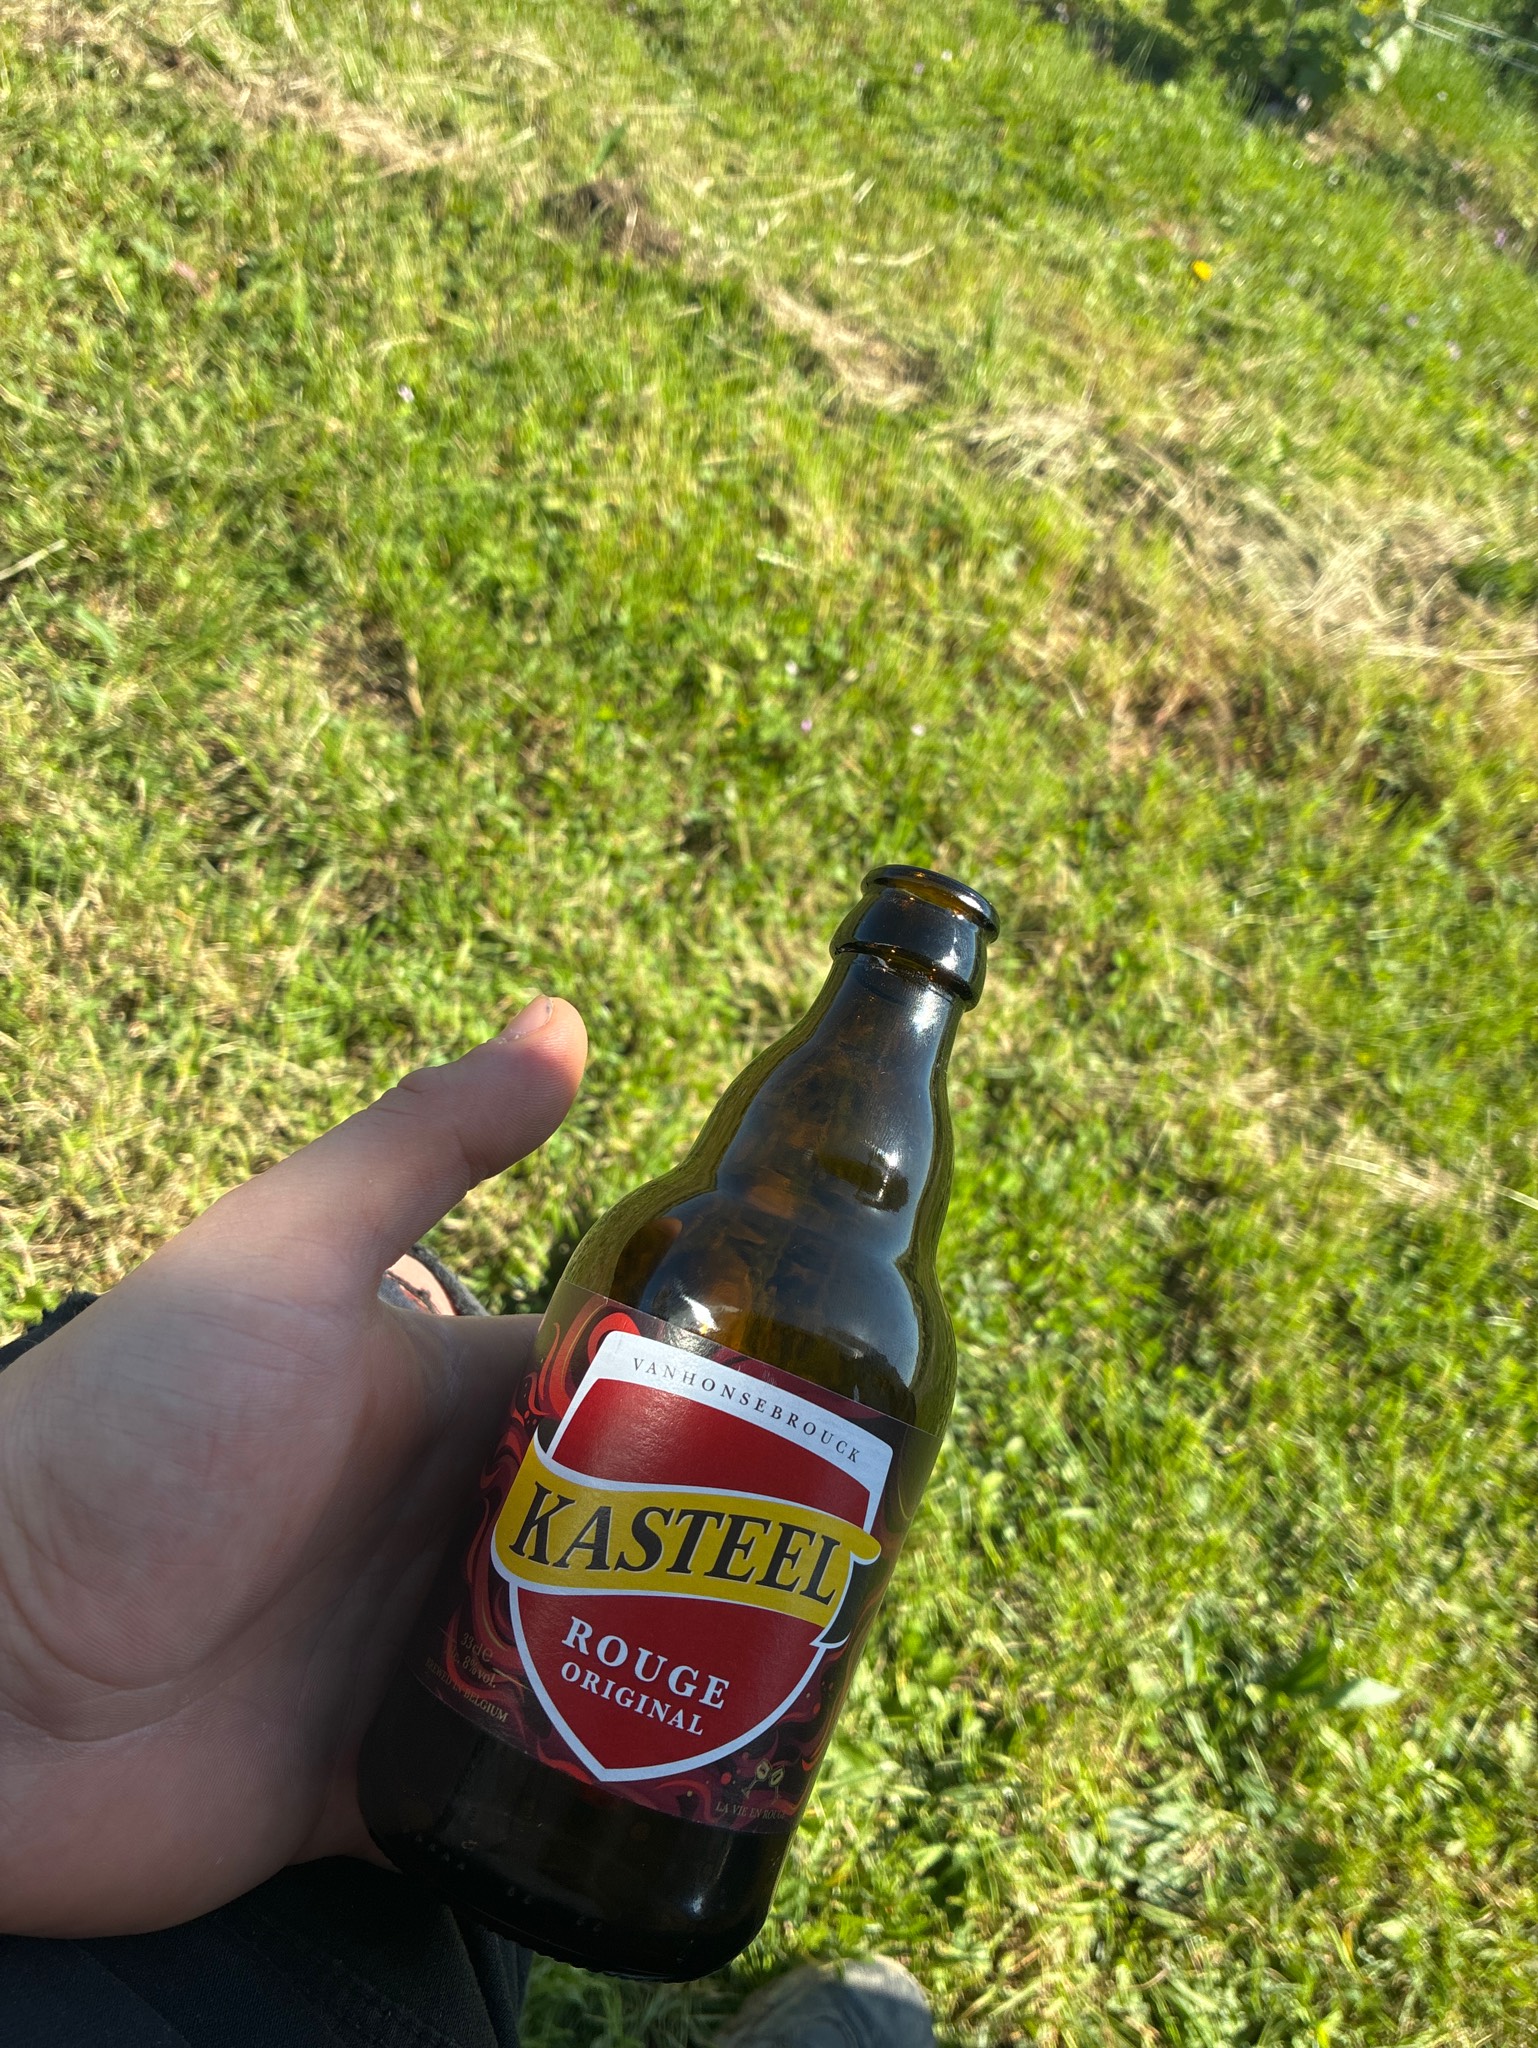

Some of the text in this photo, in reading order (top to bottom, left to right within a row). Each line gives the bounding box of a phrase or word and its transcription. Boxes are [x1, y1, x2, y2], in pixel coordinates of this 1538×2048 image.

[632, 1357, 861, 1464] VANHONSEBROUCK
[508, 1481, 841, 1606] KASTEEL
[465, 1688, 508, 1722] BELGIUM
[560, 1661, 704, 1736] ORIGINAL
[561, 1615, 730, 1710] ROUGE
[715, 1801, 729, 1814] LA
[732, 1804, 748, 1817] VIE
[749, 1808, 762, 1819] EN
